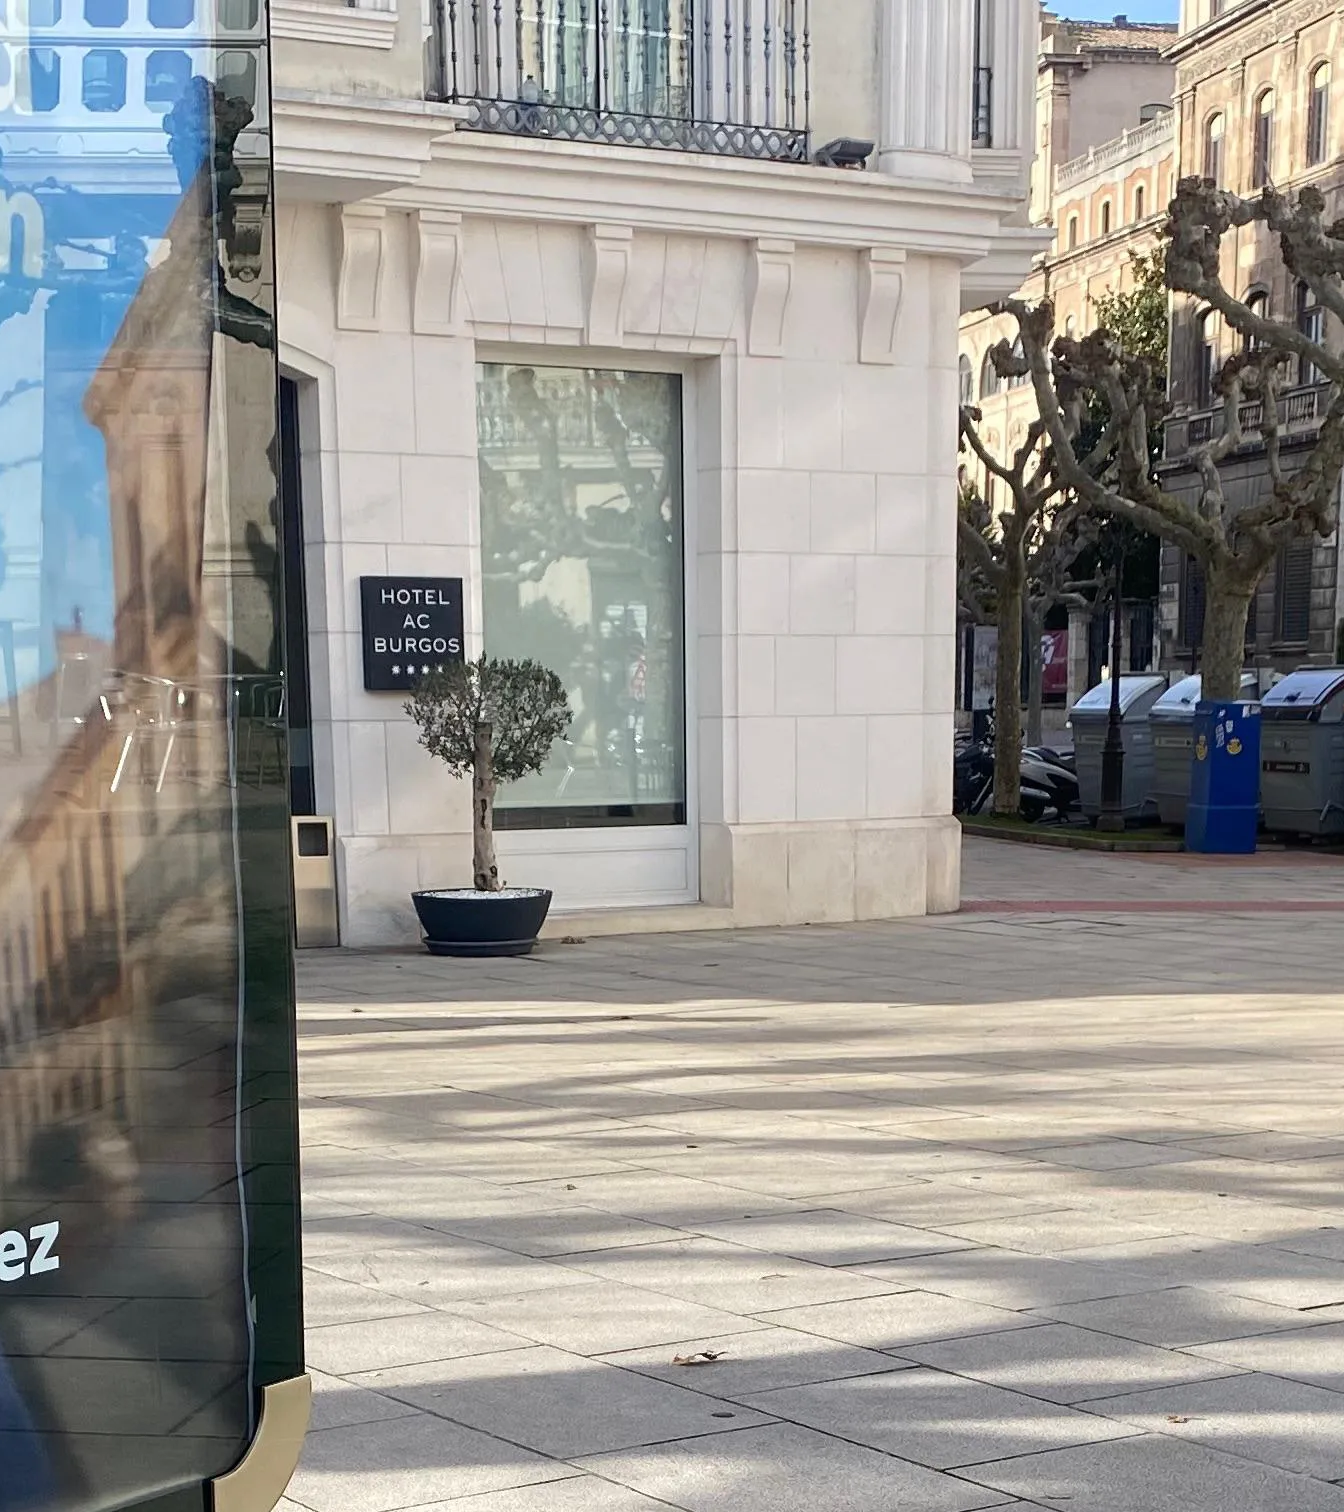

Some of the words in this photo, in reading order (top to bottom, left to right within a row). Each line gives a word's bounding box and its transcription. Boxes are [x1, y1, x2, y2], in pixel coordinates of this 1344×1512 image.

[380, 588, 451, 606] HOTEL
[402, 613, 431, 630] AC
[373, 636, 461, 654] BURGOS
